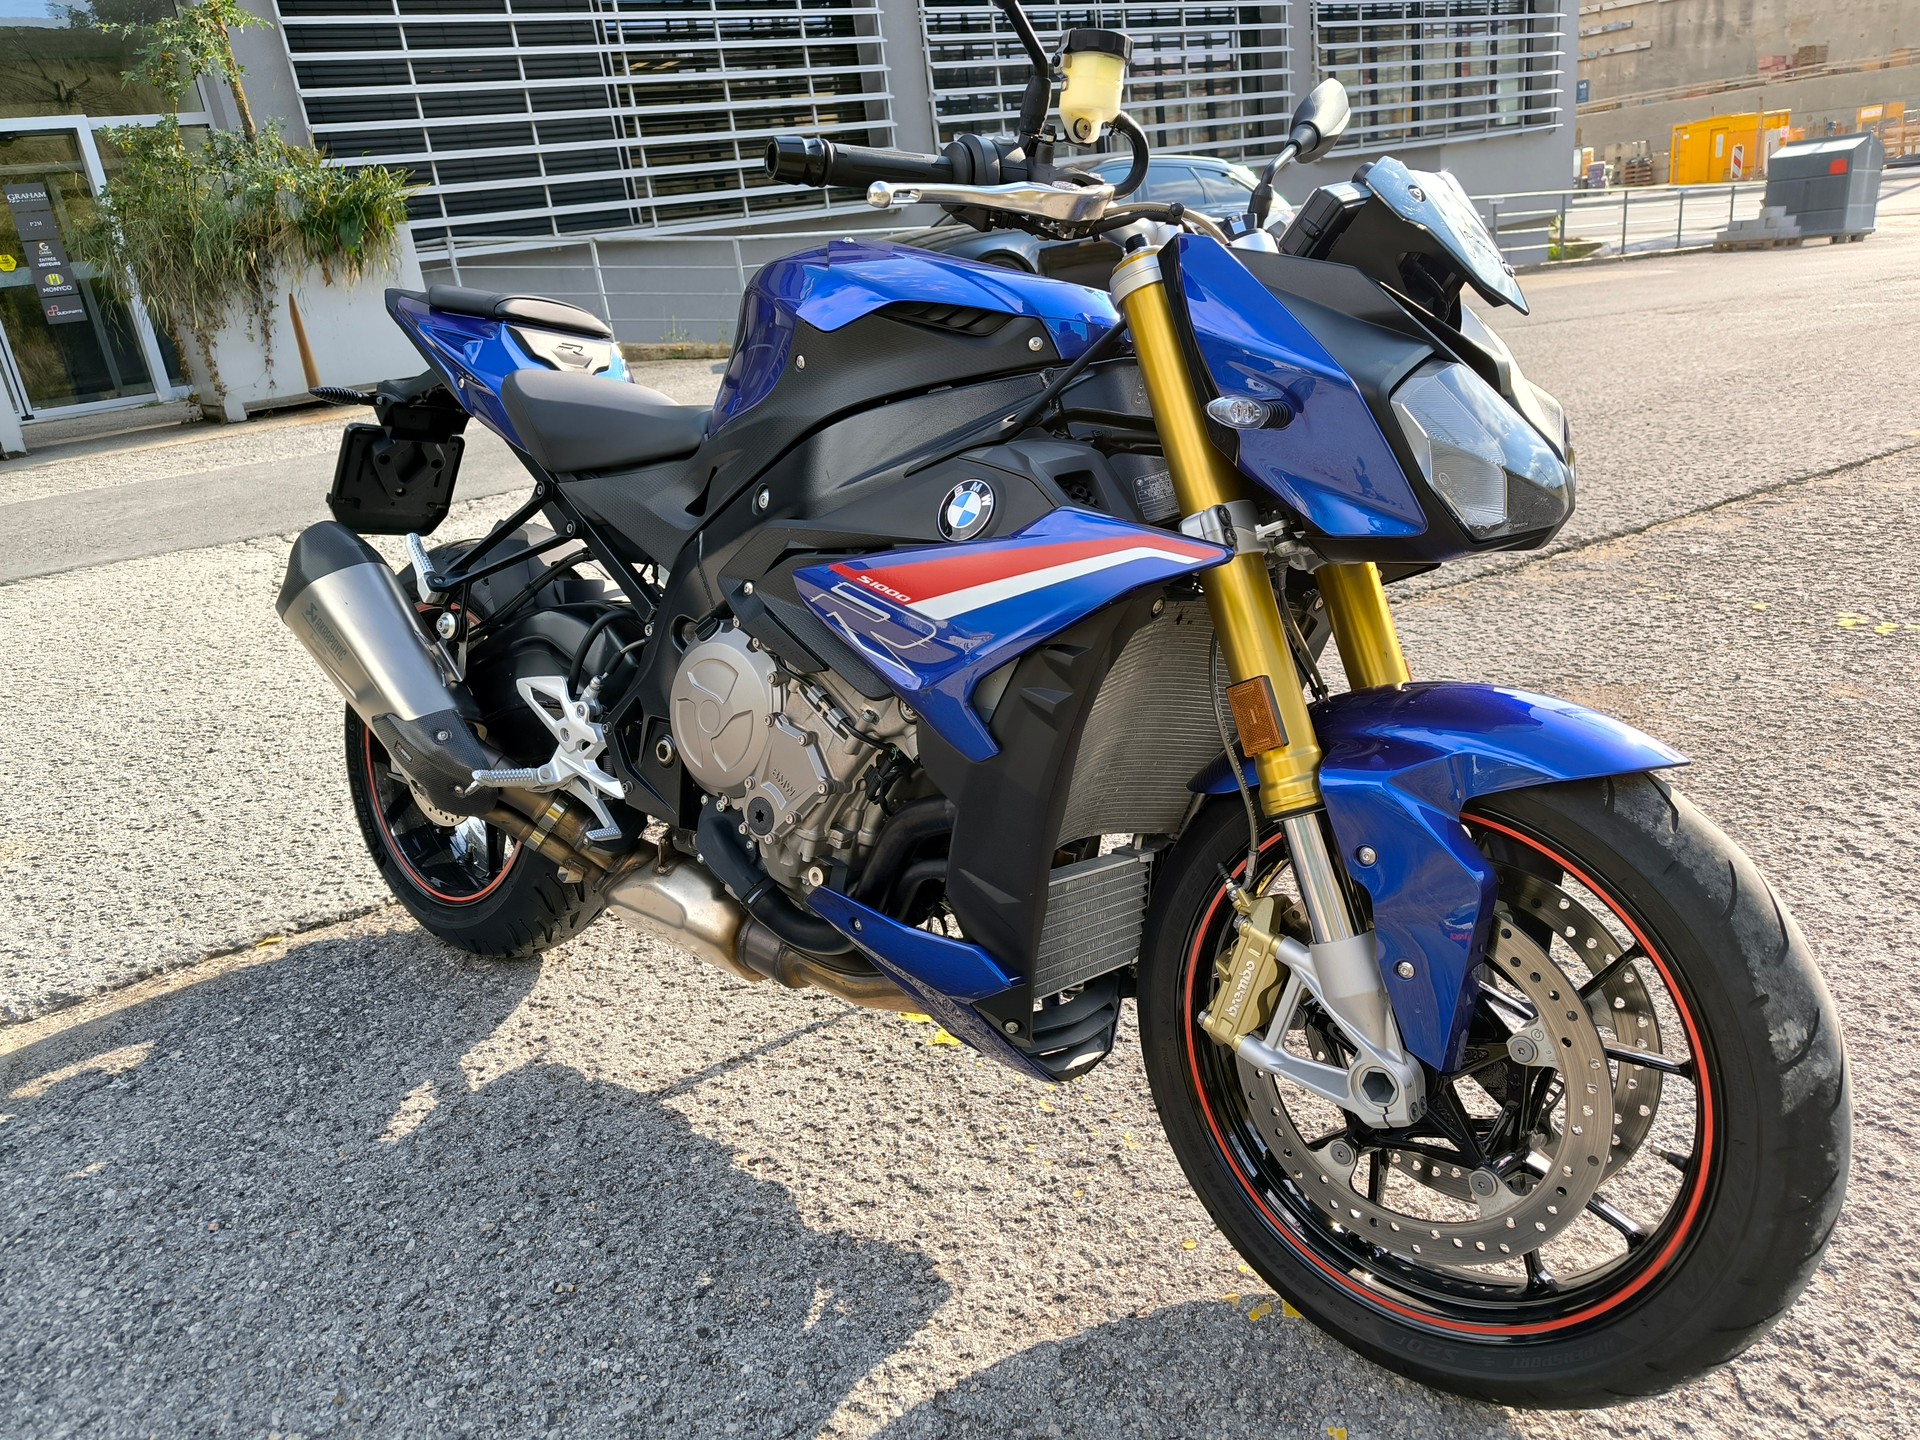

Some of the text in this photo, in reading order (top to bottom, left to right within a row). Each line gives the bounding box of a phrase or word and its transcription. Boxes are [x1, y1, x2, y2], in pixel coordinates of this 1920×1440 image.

[7, 191, 47, 201] GRAHAM
[42, 285, 72, 293] MONYCO
[954, 482, 991, 506] BMW
[857, 575, 911, 602] S1000
[771, 767, 797, 798] BMW
[1225, 960, 1256, 1018] brembo
